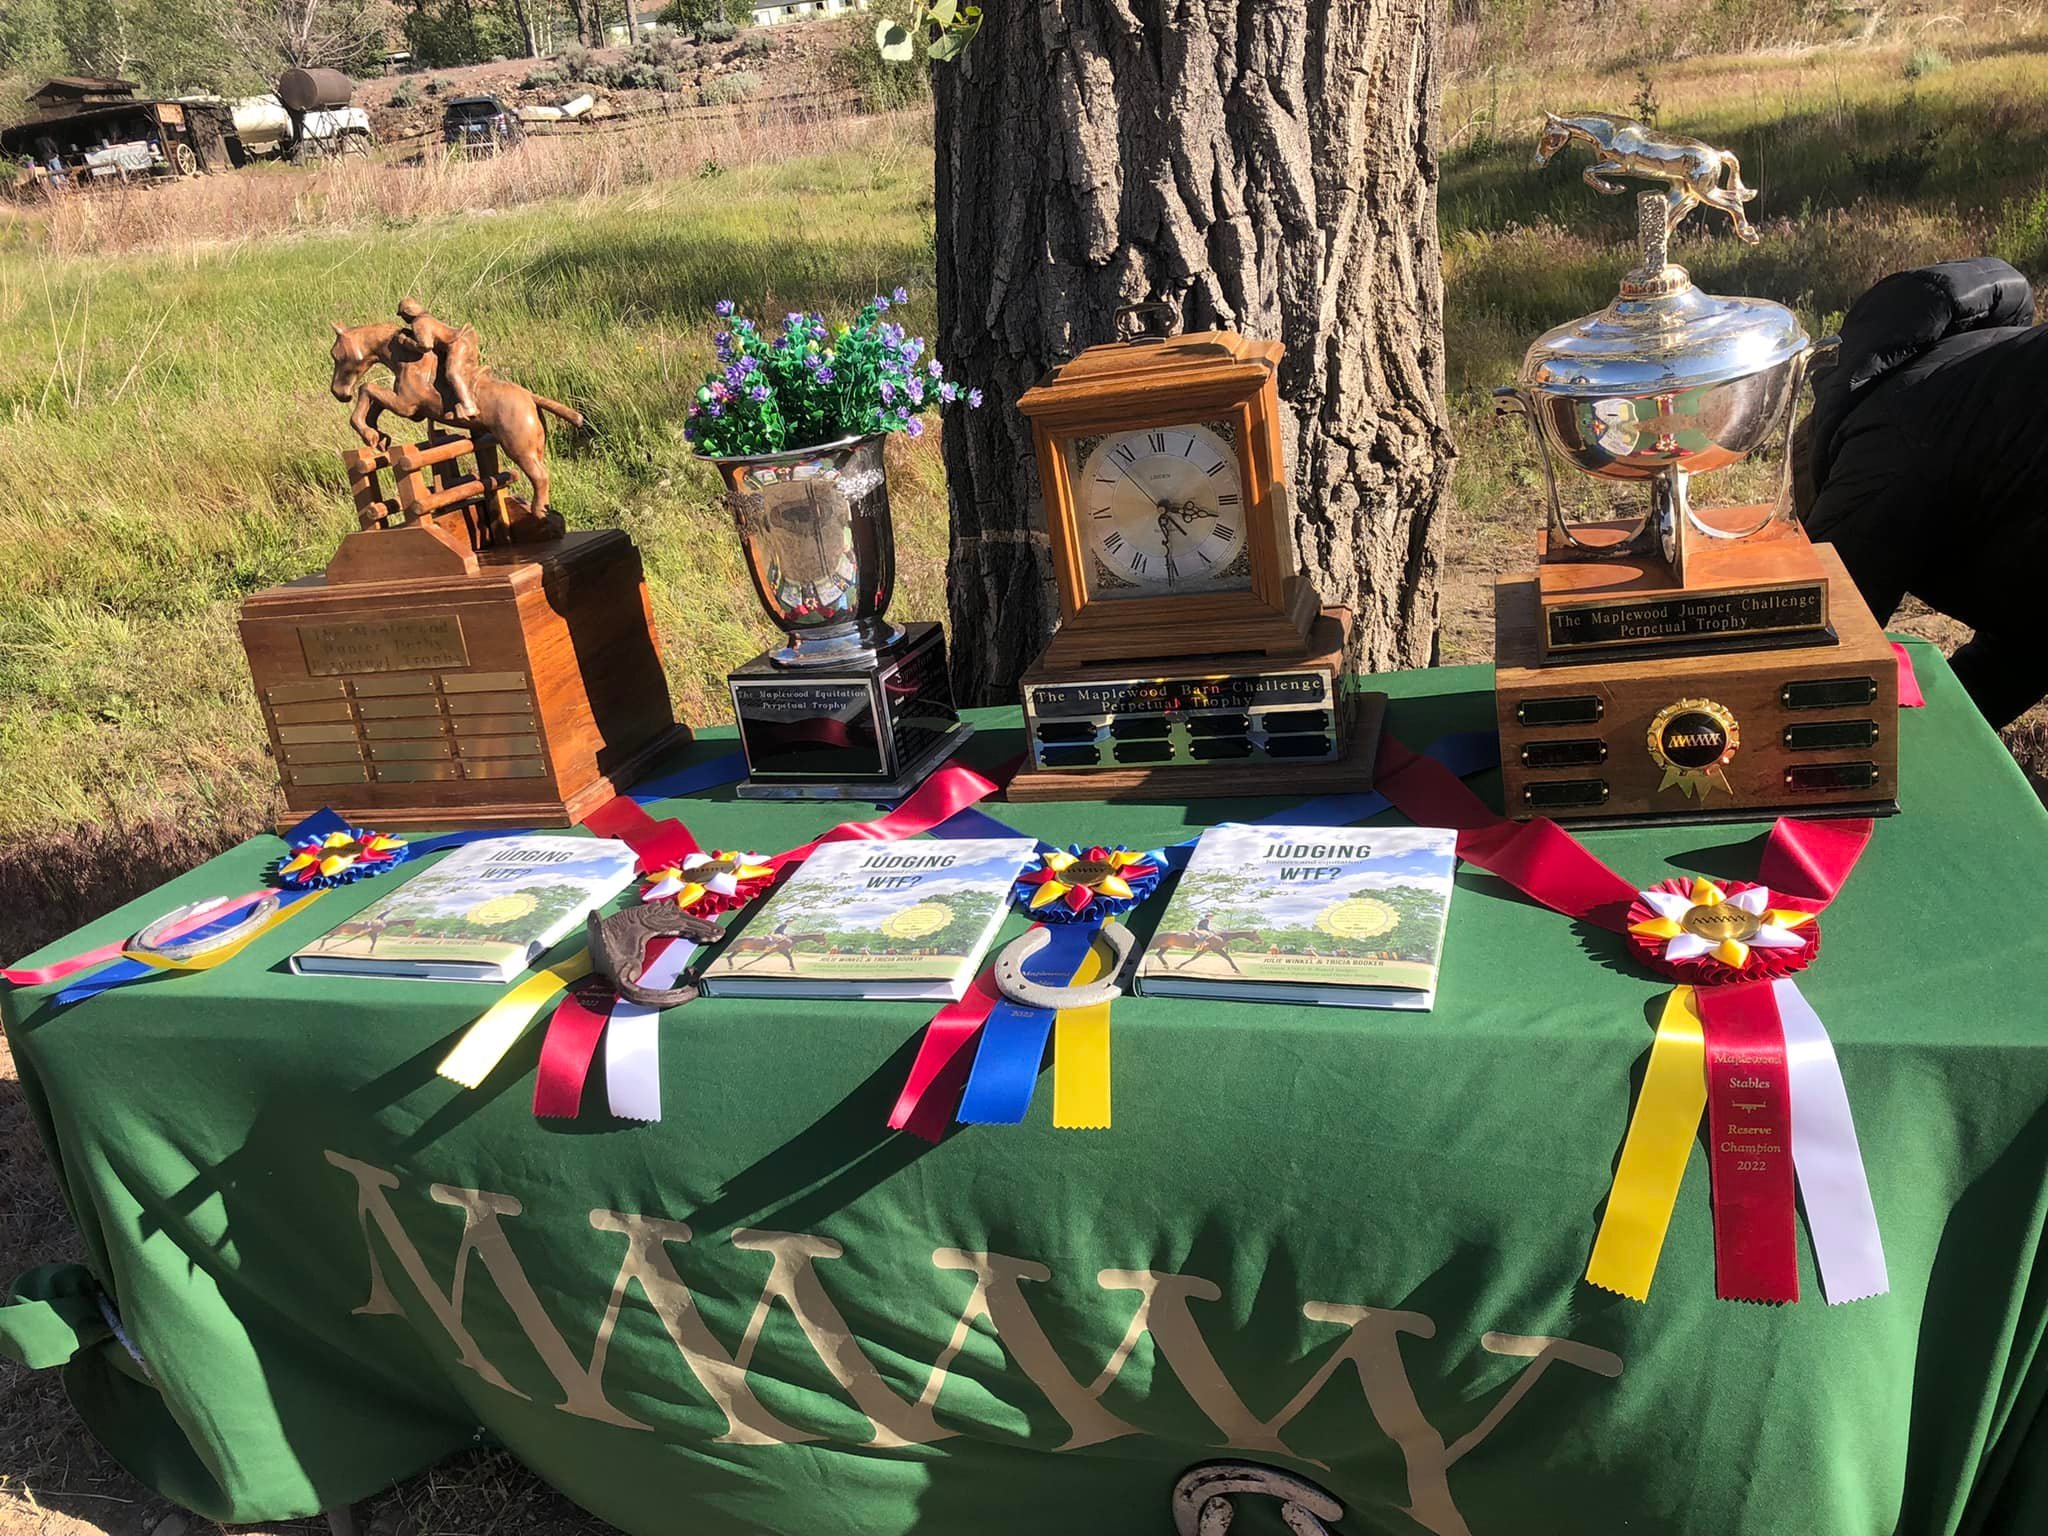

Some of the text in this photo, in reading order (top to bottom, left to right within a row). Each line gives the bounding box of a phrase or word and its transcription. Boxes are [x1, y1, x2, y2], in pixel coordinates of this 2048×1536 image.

[1556, 595, 1816, 628] The Maplewood Jumper Challenge
[1620, 616, 1748, 637] Perpetual Trophy
[815, 689, 867, 700] Equitation
[1035, 680, 1320, 702] The Maplewood Barn Challenge
[762, 702, 847, 711] Perpetual Trophy
[1101, 695, 1252, 712] Perpetual Trophy
[485, 850, 575, 862] JUDGING
[1262, 845, 1372, 859] JUDGING
[859, 855, 957, 868] JUDGING
[479, 868, 533, 879] WTF?
[1279, 867, 1342, 880] WTF?
[866, 875, 923, 888] WTF?
[1729, 1077, 1770, 1088] Stables
[1728, 1124, 1772, 1135] Reserve
[1720, 1141, 1781, 1155] Champion
[1737, 1161, 1767, 1171] 2022
